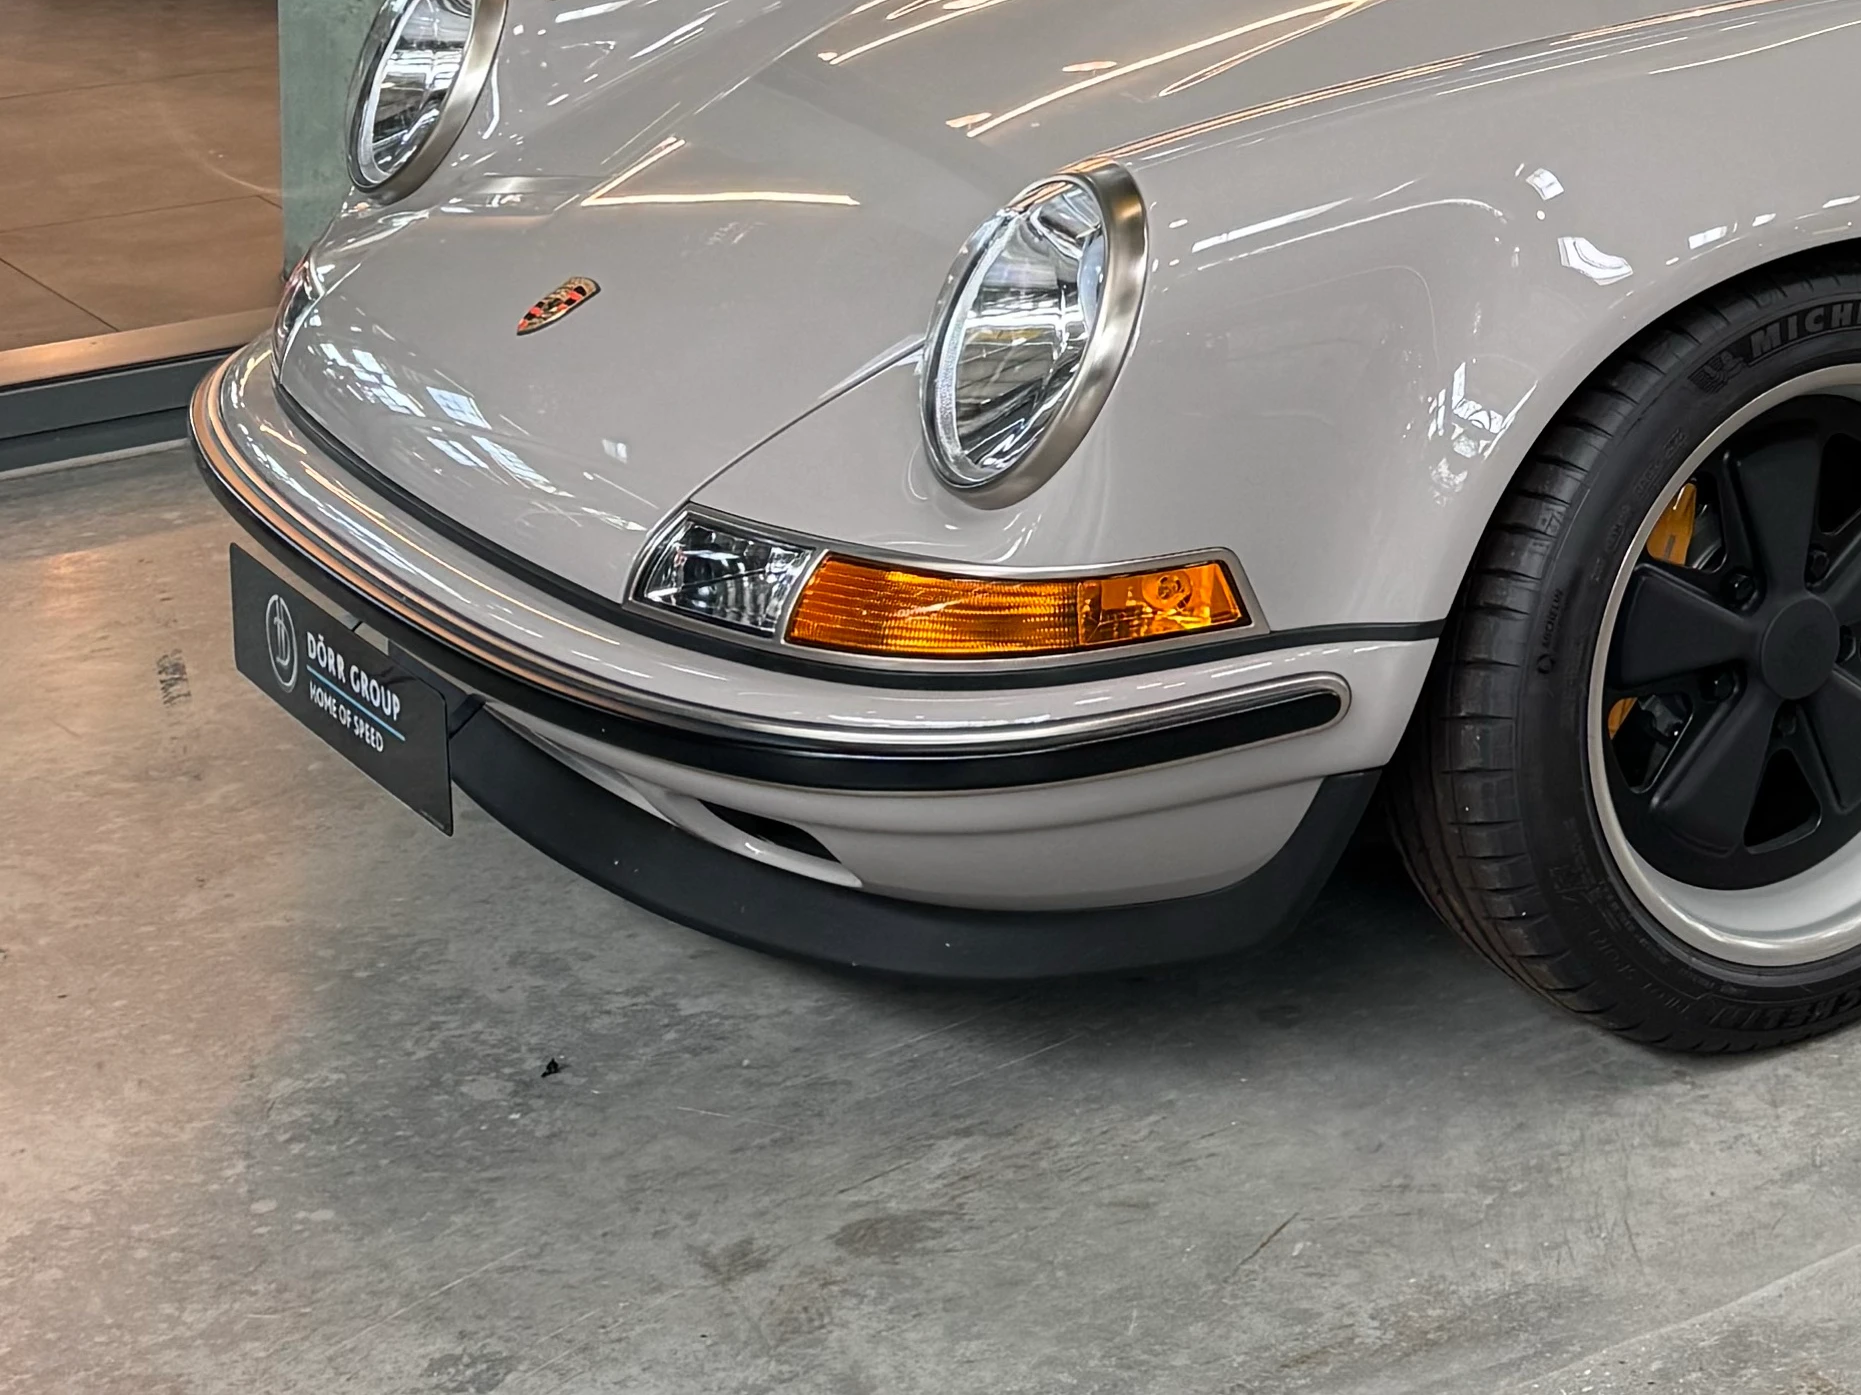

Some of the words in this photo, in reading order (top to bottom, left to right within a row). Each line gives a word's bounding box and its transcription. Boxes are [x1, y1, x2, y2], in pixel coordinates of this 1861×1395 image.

[306, 630, 346, 684] DÖRR
[350, 664, 401, 721] GROUP
[309, 680, 339, 720] HOME
[339, 704, 352, 729] OF
[353, 716, 384, 754] SPEED
